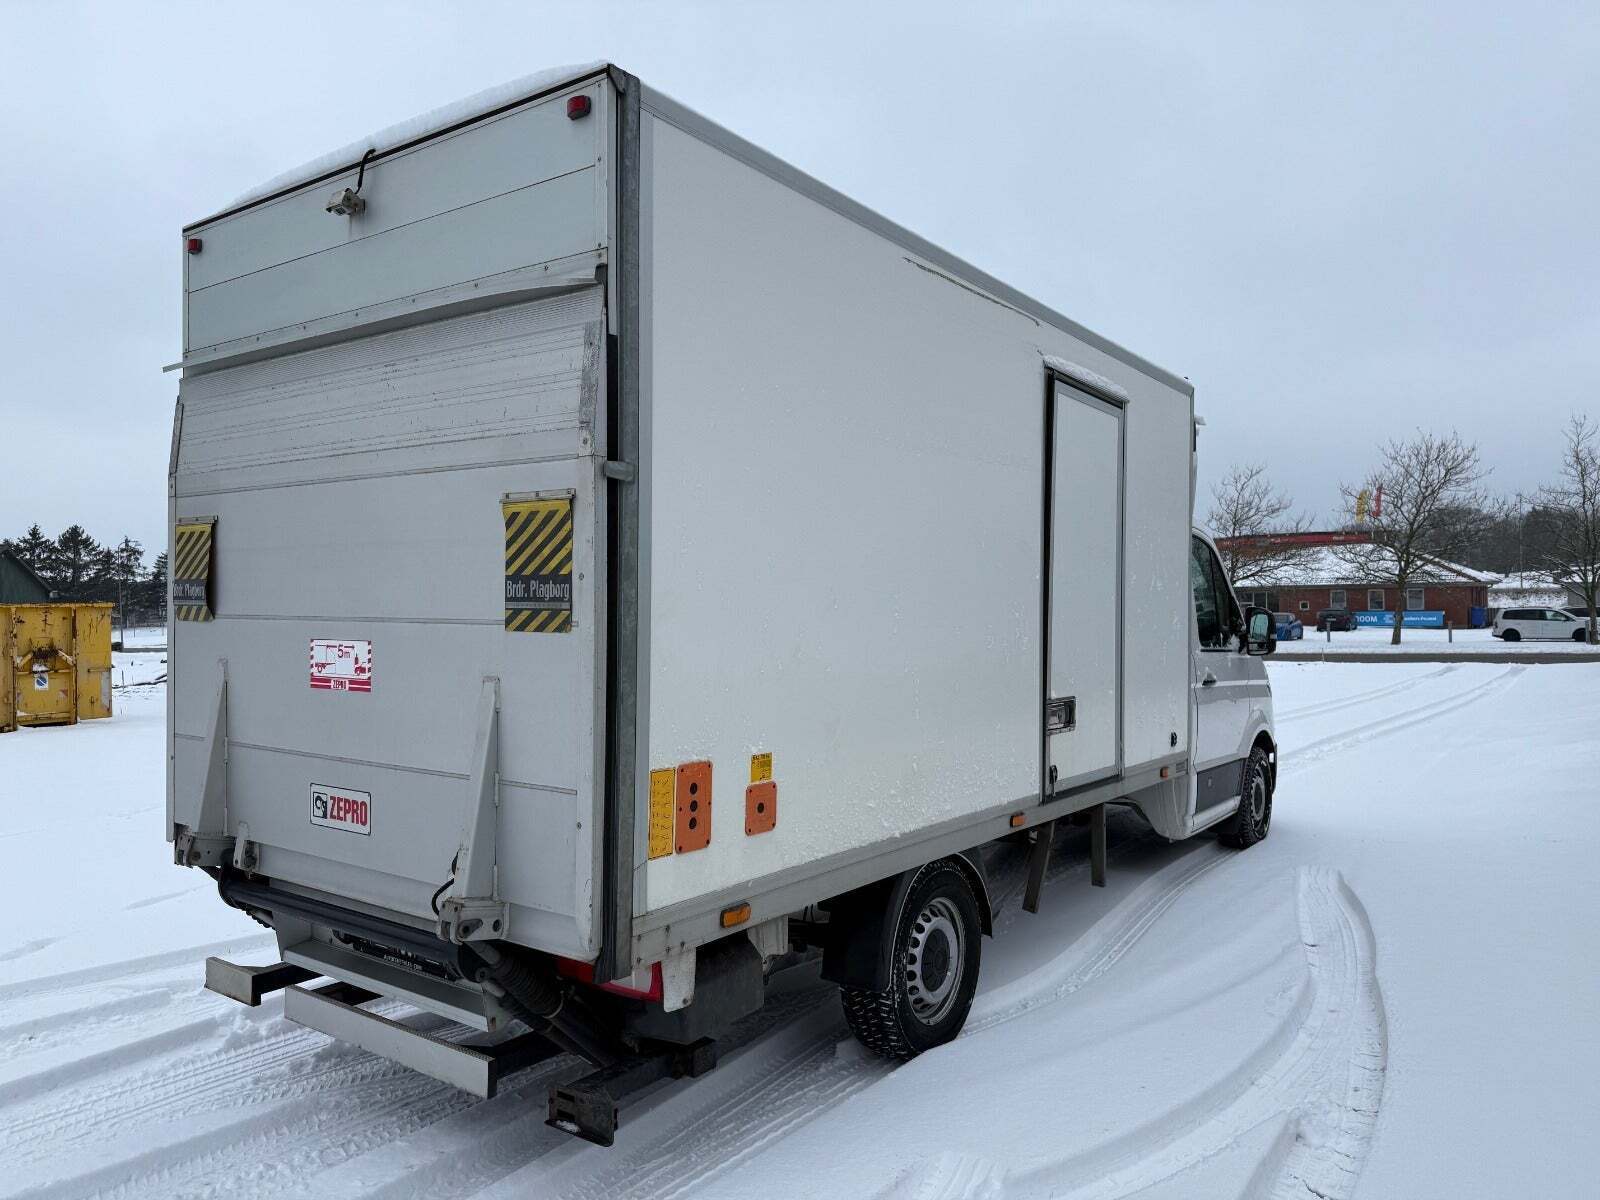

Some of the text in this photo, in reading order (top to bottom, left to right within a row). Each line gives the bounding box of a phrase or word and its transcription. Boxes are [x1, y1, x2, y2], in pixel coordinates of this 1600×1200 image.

[506, 580, 570, 601] Brdr. Plagborg
[330, 795, 368, 826] ZEPRO
